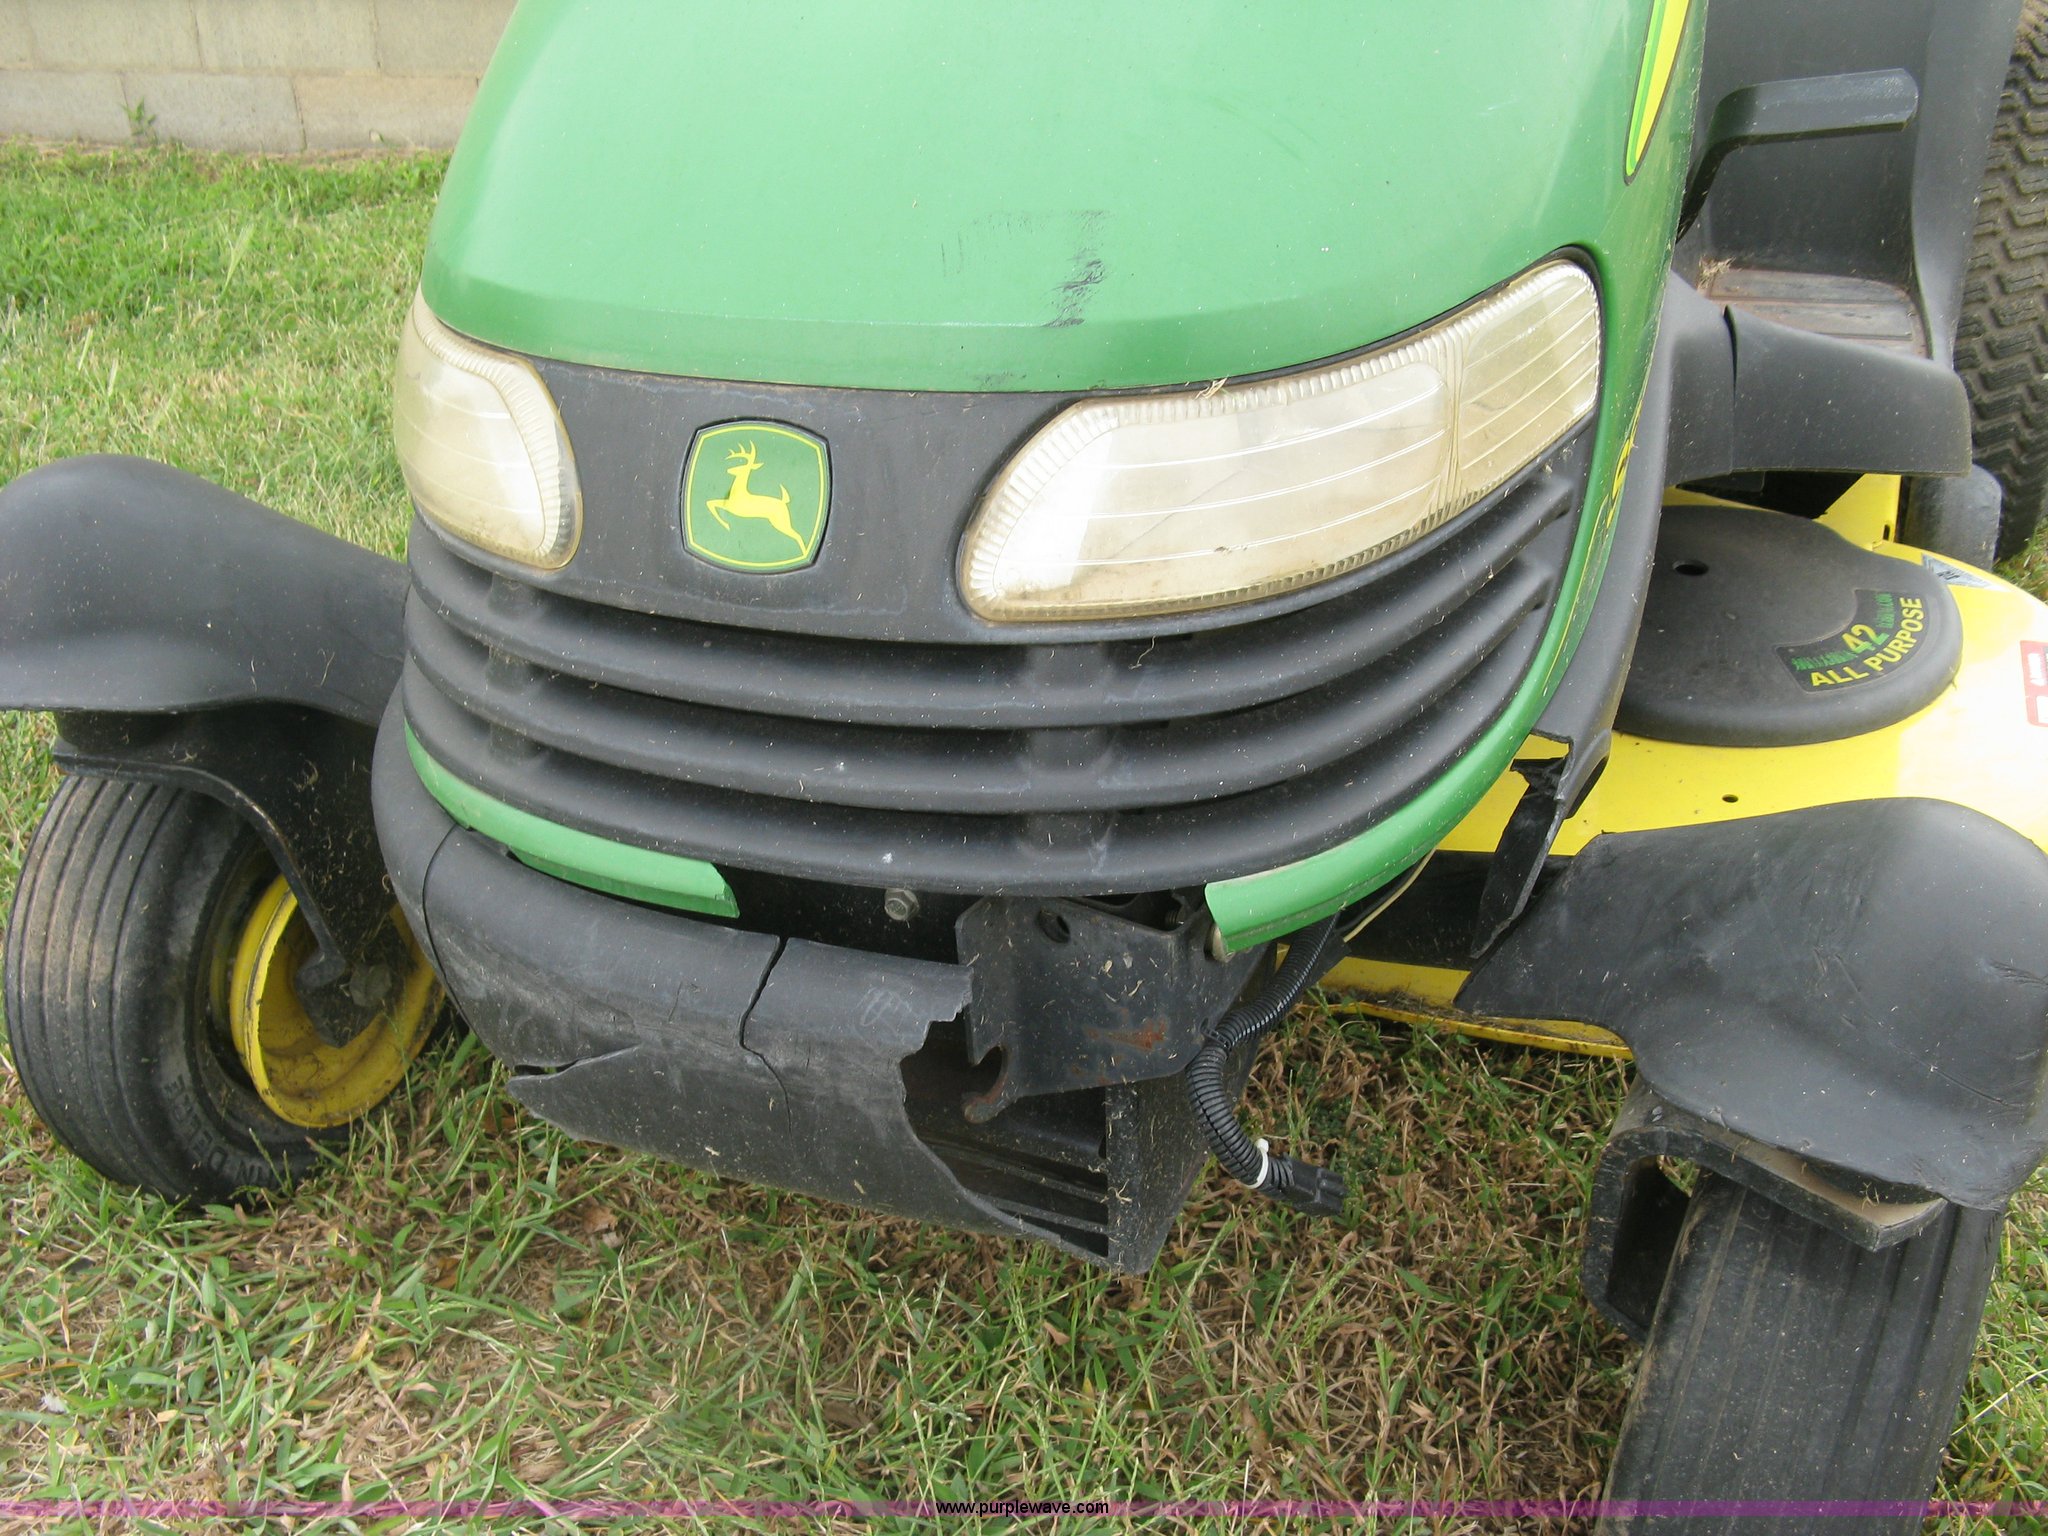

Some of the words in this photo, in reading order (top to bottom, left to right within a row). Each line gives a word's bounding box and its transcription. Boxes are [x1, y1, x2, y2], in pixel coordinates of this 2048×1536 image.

[1810, 666, 1870, 686] ALL
[1863, 597, 1925, 672] PURPOSE
[1842, 624, 1890, 654] 42
